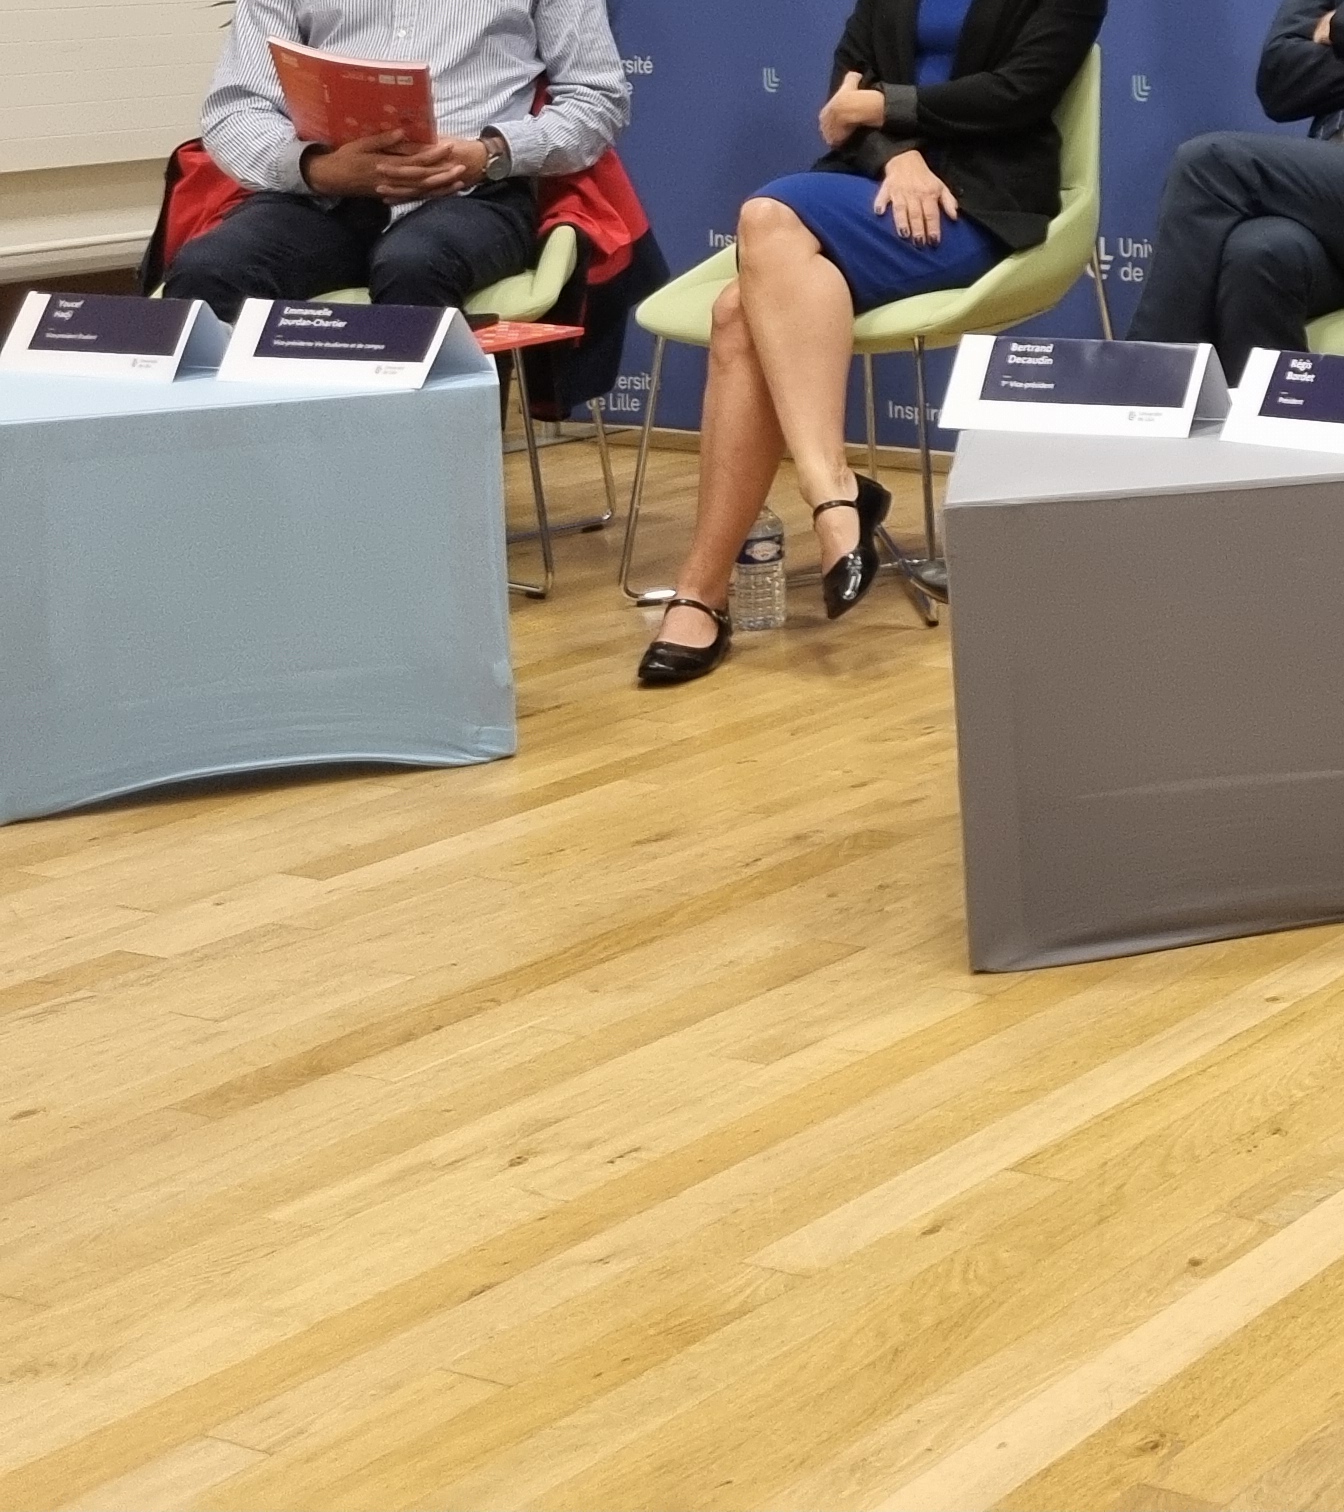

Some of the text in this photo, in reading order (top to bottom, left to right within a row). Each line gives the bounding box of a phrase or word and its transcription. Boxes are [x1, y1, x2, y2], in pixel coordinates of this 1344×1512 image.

[1119, 261, 1144, 282] de
[1010, 342, 1054, 353] Bertrand
[1007, 354, 1053, 365] Decaudin
[609, 392, 641, 412] Lille
